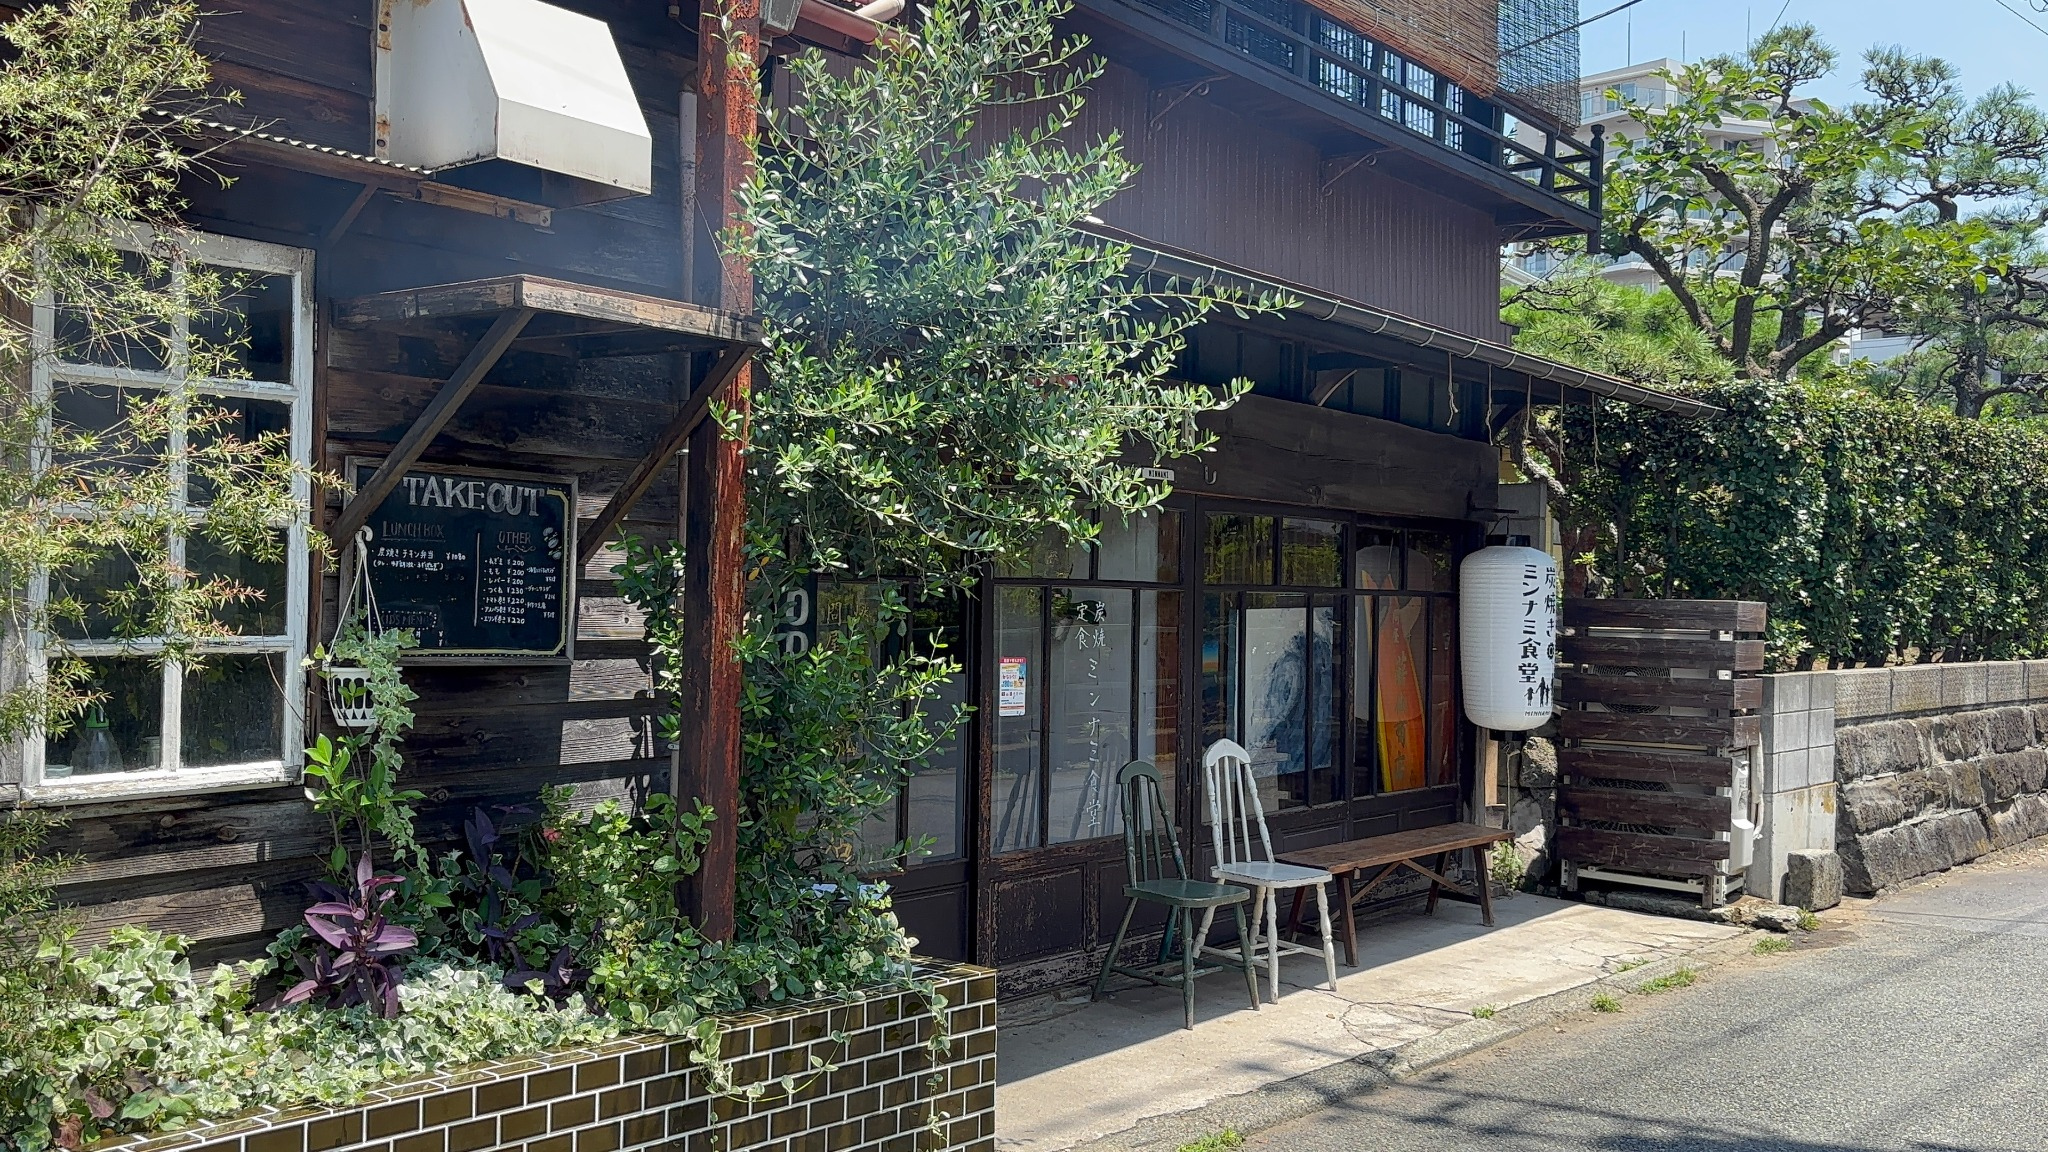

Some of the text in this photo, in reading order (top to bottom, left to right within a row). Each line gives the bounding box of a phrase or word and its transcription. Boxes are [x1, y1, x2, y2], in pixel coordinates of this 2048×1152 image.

[382, 520, 445, 538] LUNCH BOX
[498, 531, 531, 544] OTHER
[488, 568, 500, 576] もも
[507, 606, 524, 614] ¥220
[507, 616, 526, 624] ¥220
[1518, 564, 1542, 684] ミンナミ食堂
